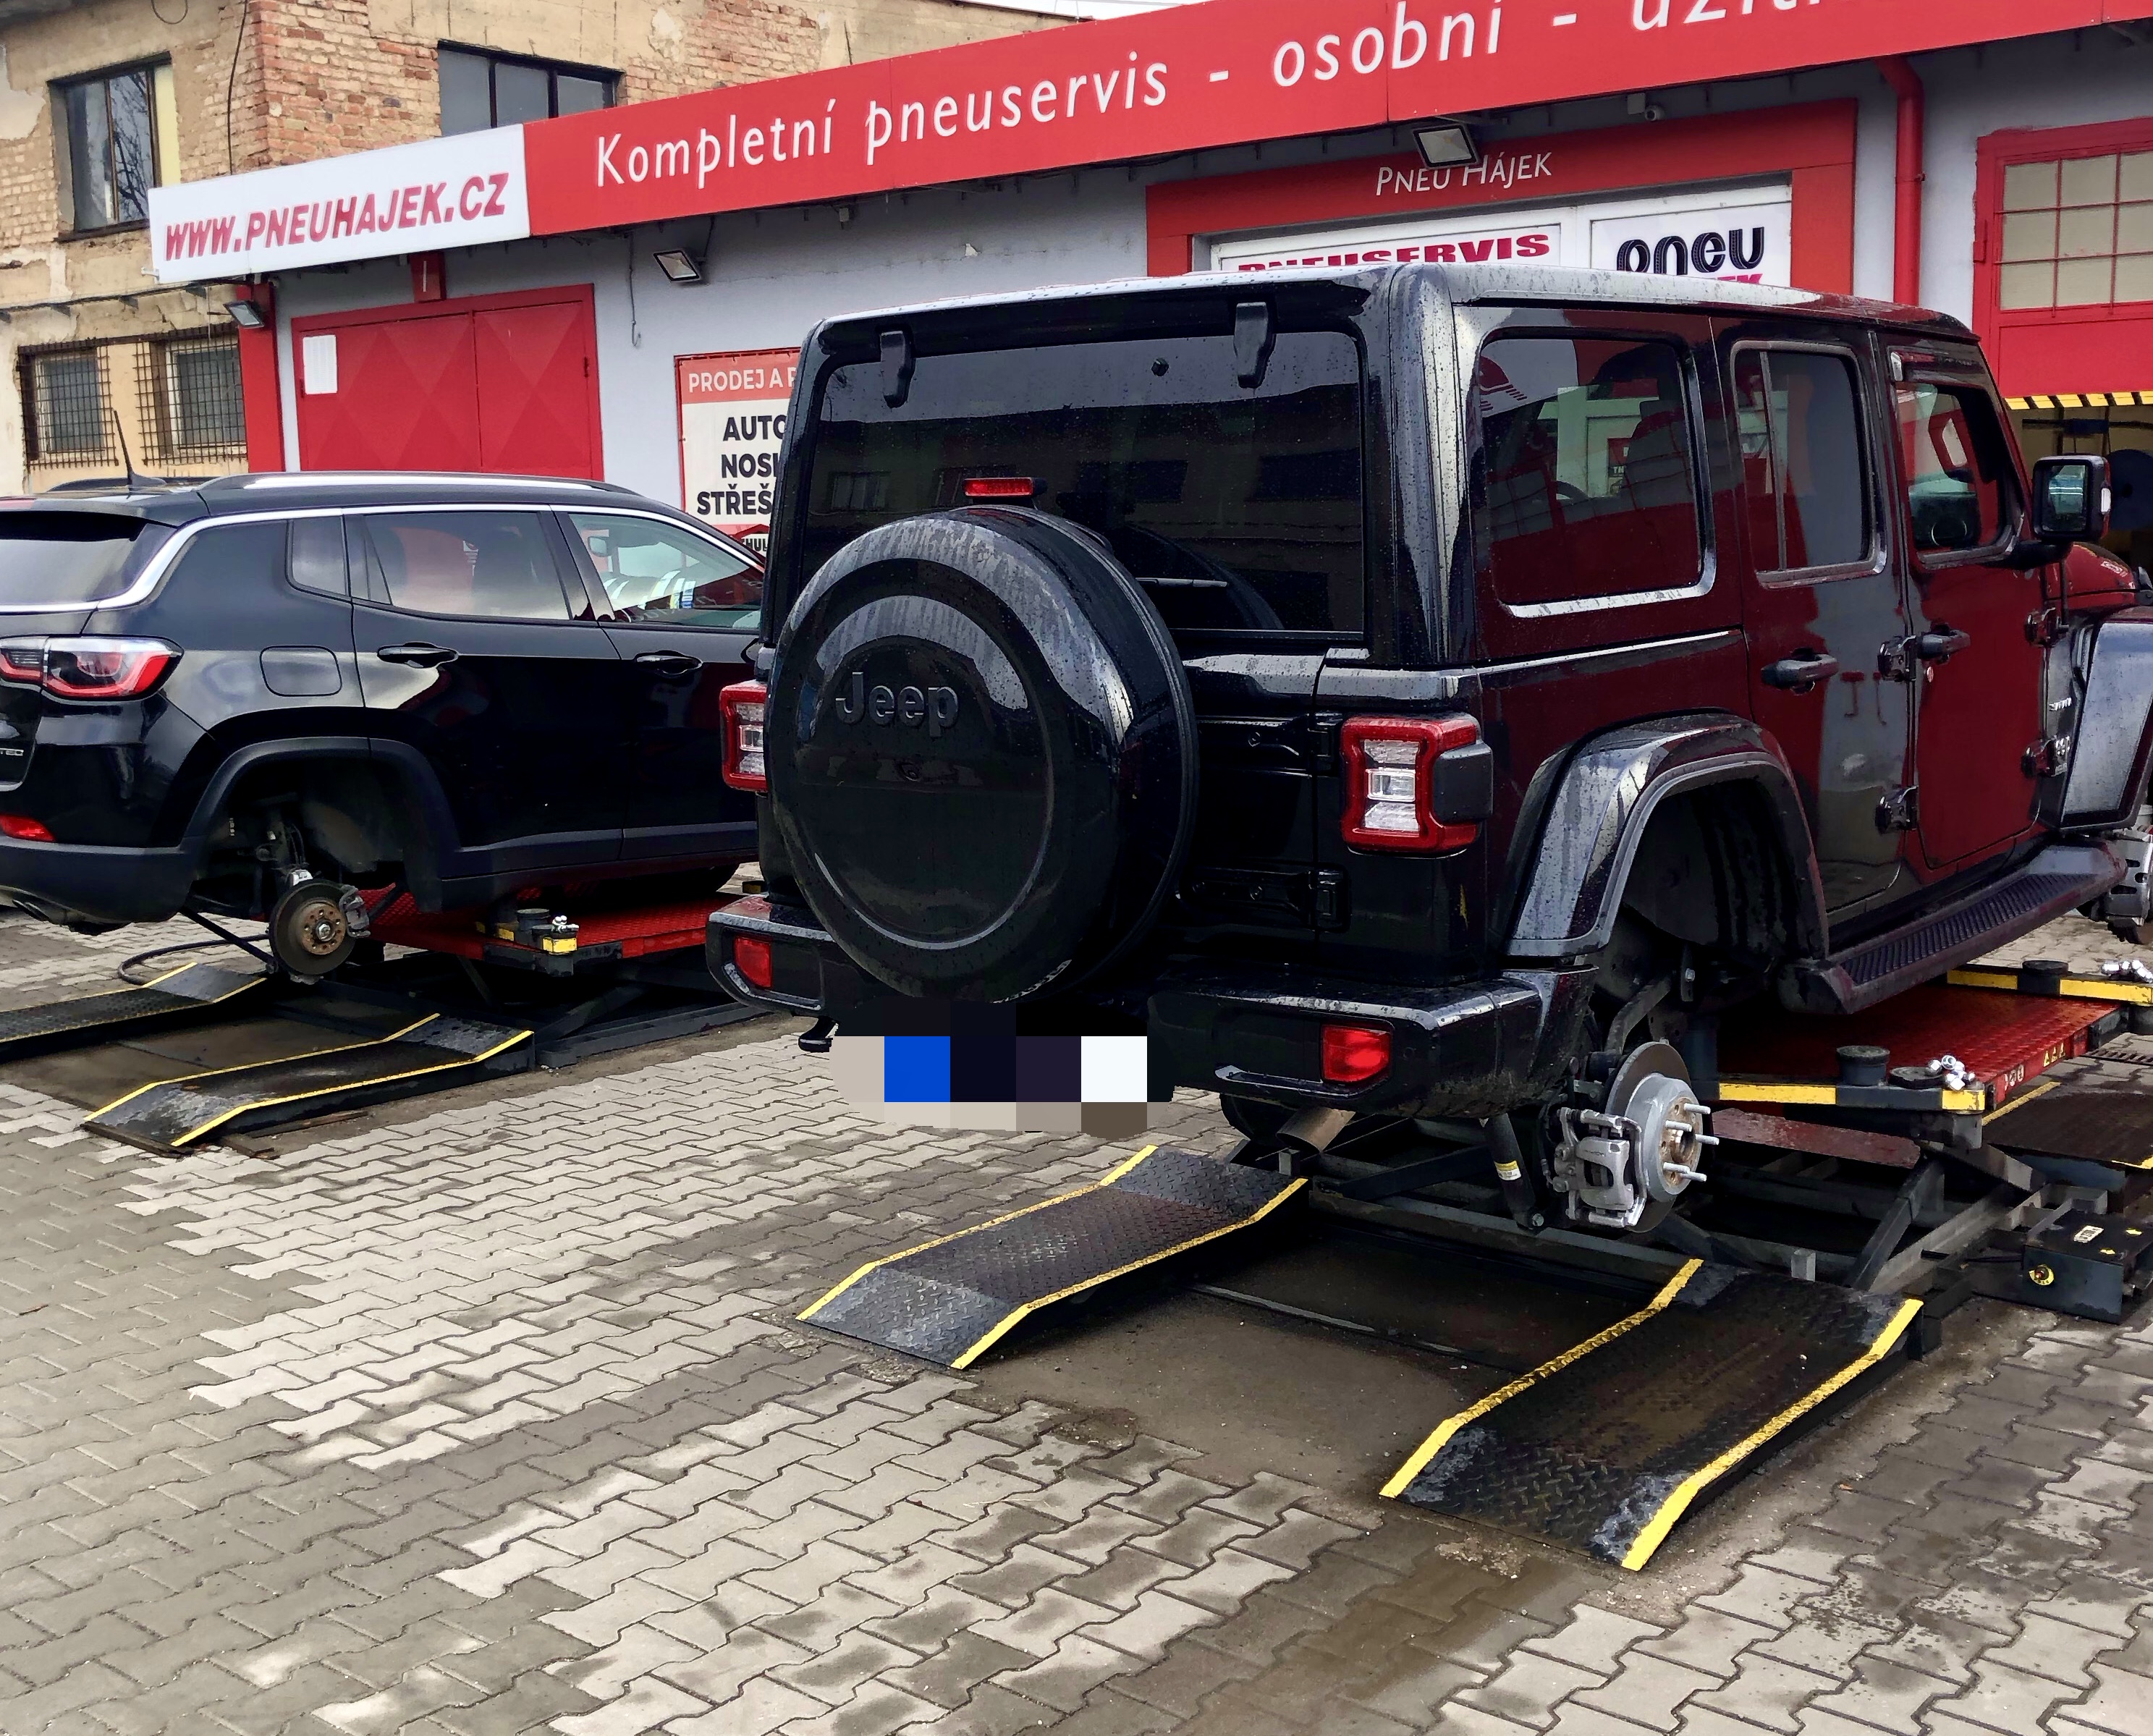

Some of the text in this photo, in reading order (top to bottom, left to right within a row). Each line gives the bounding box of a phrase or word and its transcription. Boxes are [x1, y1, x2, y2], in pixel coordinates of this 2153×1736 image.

[597, 98, 836, 190] Kompletní
[866, 51, 1168, 166] pneuservis
[1376, 151, 1552, 196] PNEU HÁJEK
[166, 172, 509, 261] WWW.PNEUHAJEK.CZ
[688, 368, 765, 393] PRODEJ
[769, 368, 784, 389] A
[697, 483, 773, 515] STŘEŠ
[835, 672, 959, 737] Jeep
